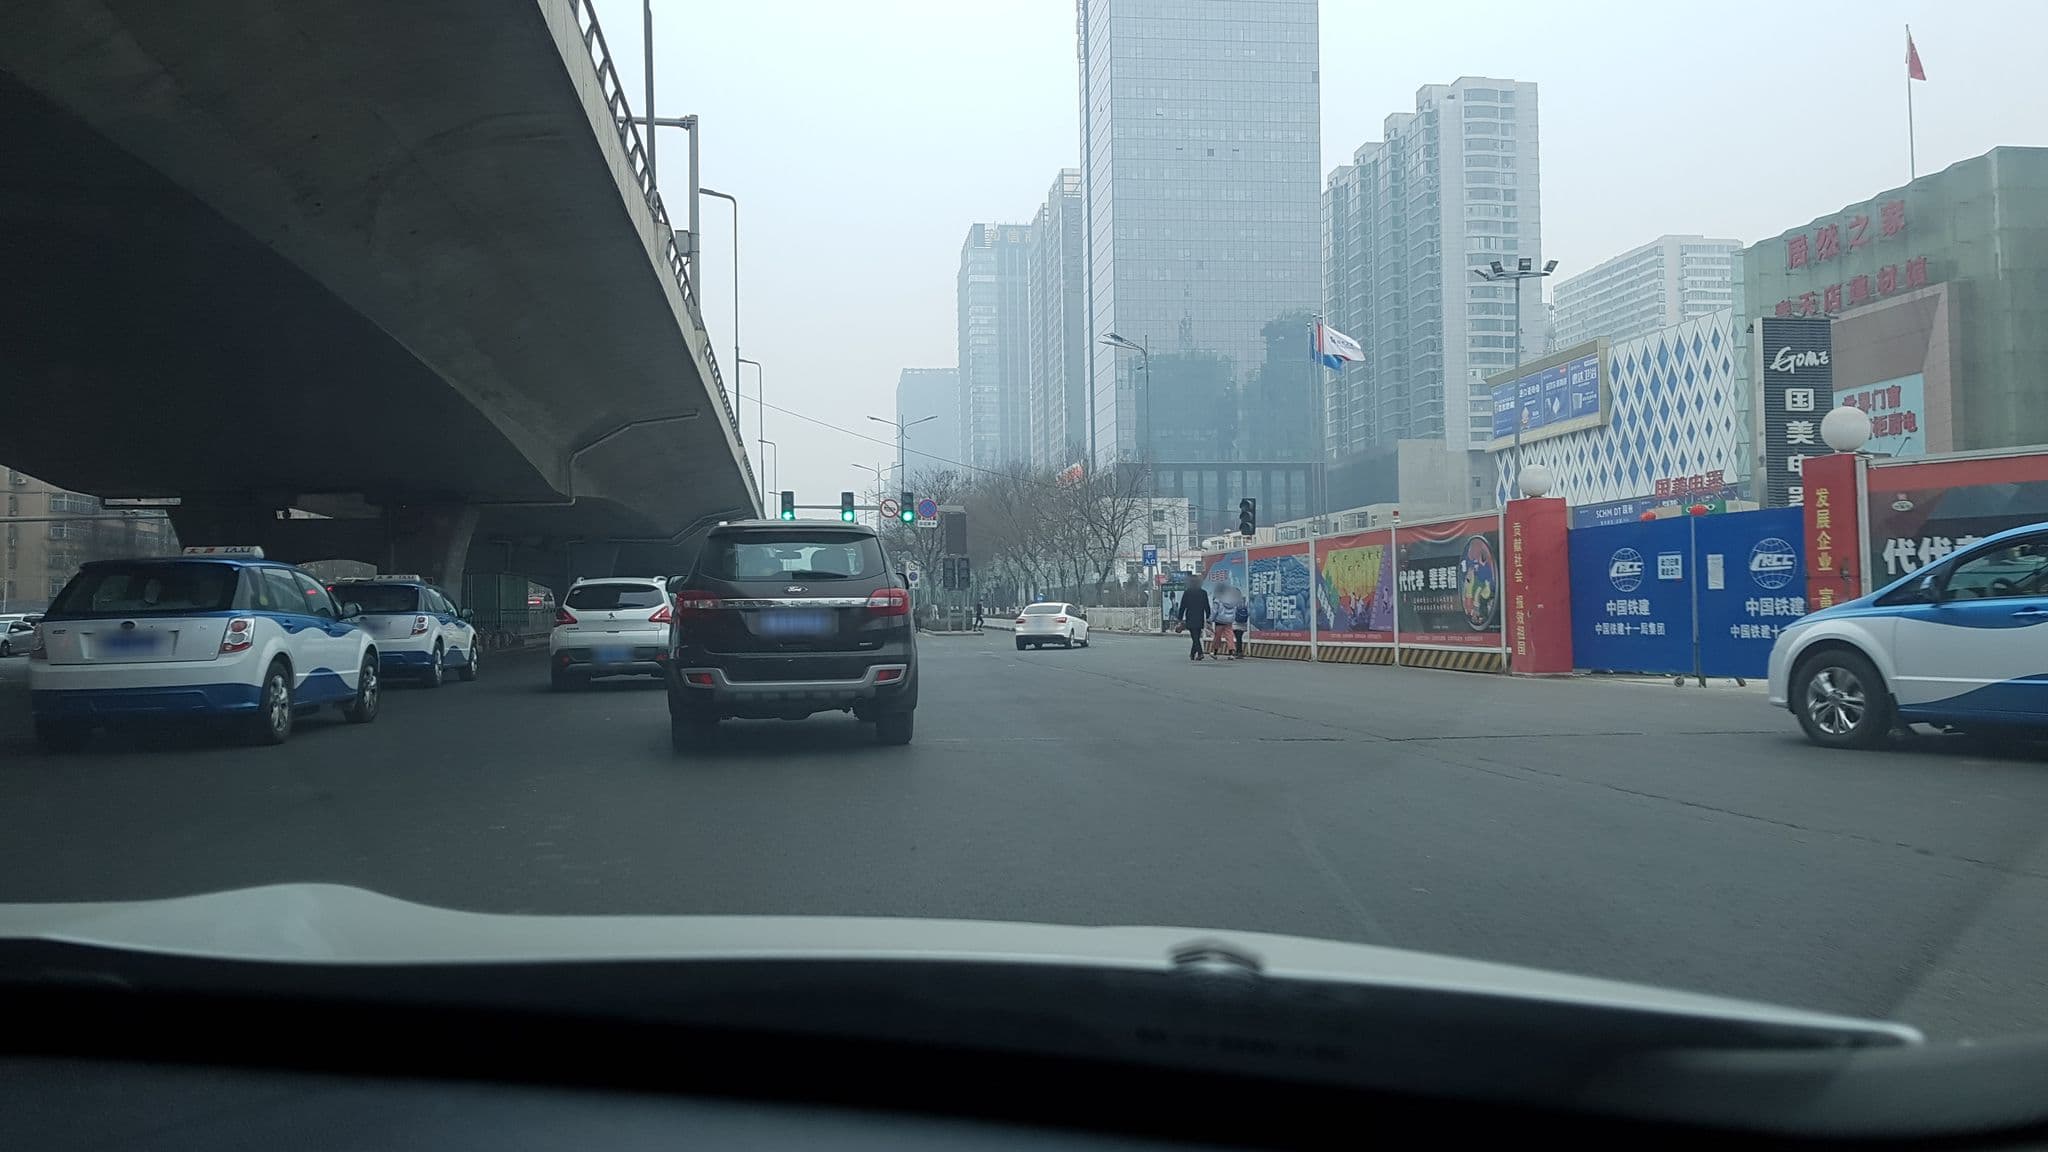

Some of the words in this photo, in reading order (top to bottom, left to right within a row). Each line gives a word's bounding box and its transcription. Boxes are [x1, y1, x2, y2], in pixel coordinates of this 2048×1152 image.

[1788, 200, 1905, 270] 居然之家
[1655, 470, 1727, 498] 国美电器
[1816, 488, 1833, 571] 发展企业
[1606, 599, 1651, 616] 中国铁建
[1745, 597, 1805, 616] 中国铁建
[1594, 621, 1666, 636] 中国铁建十一局集团
